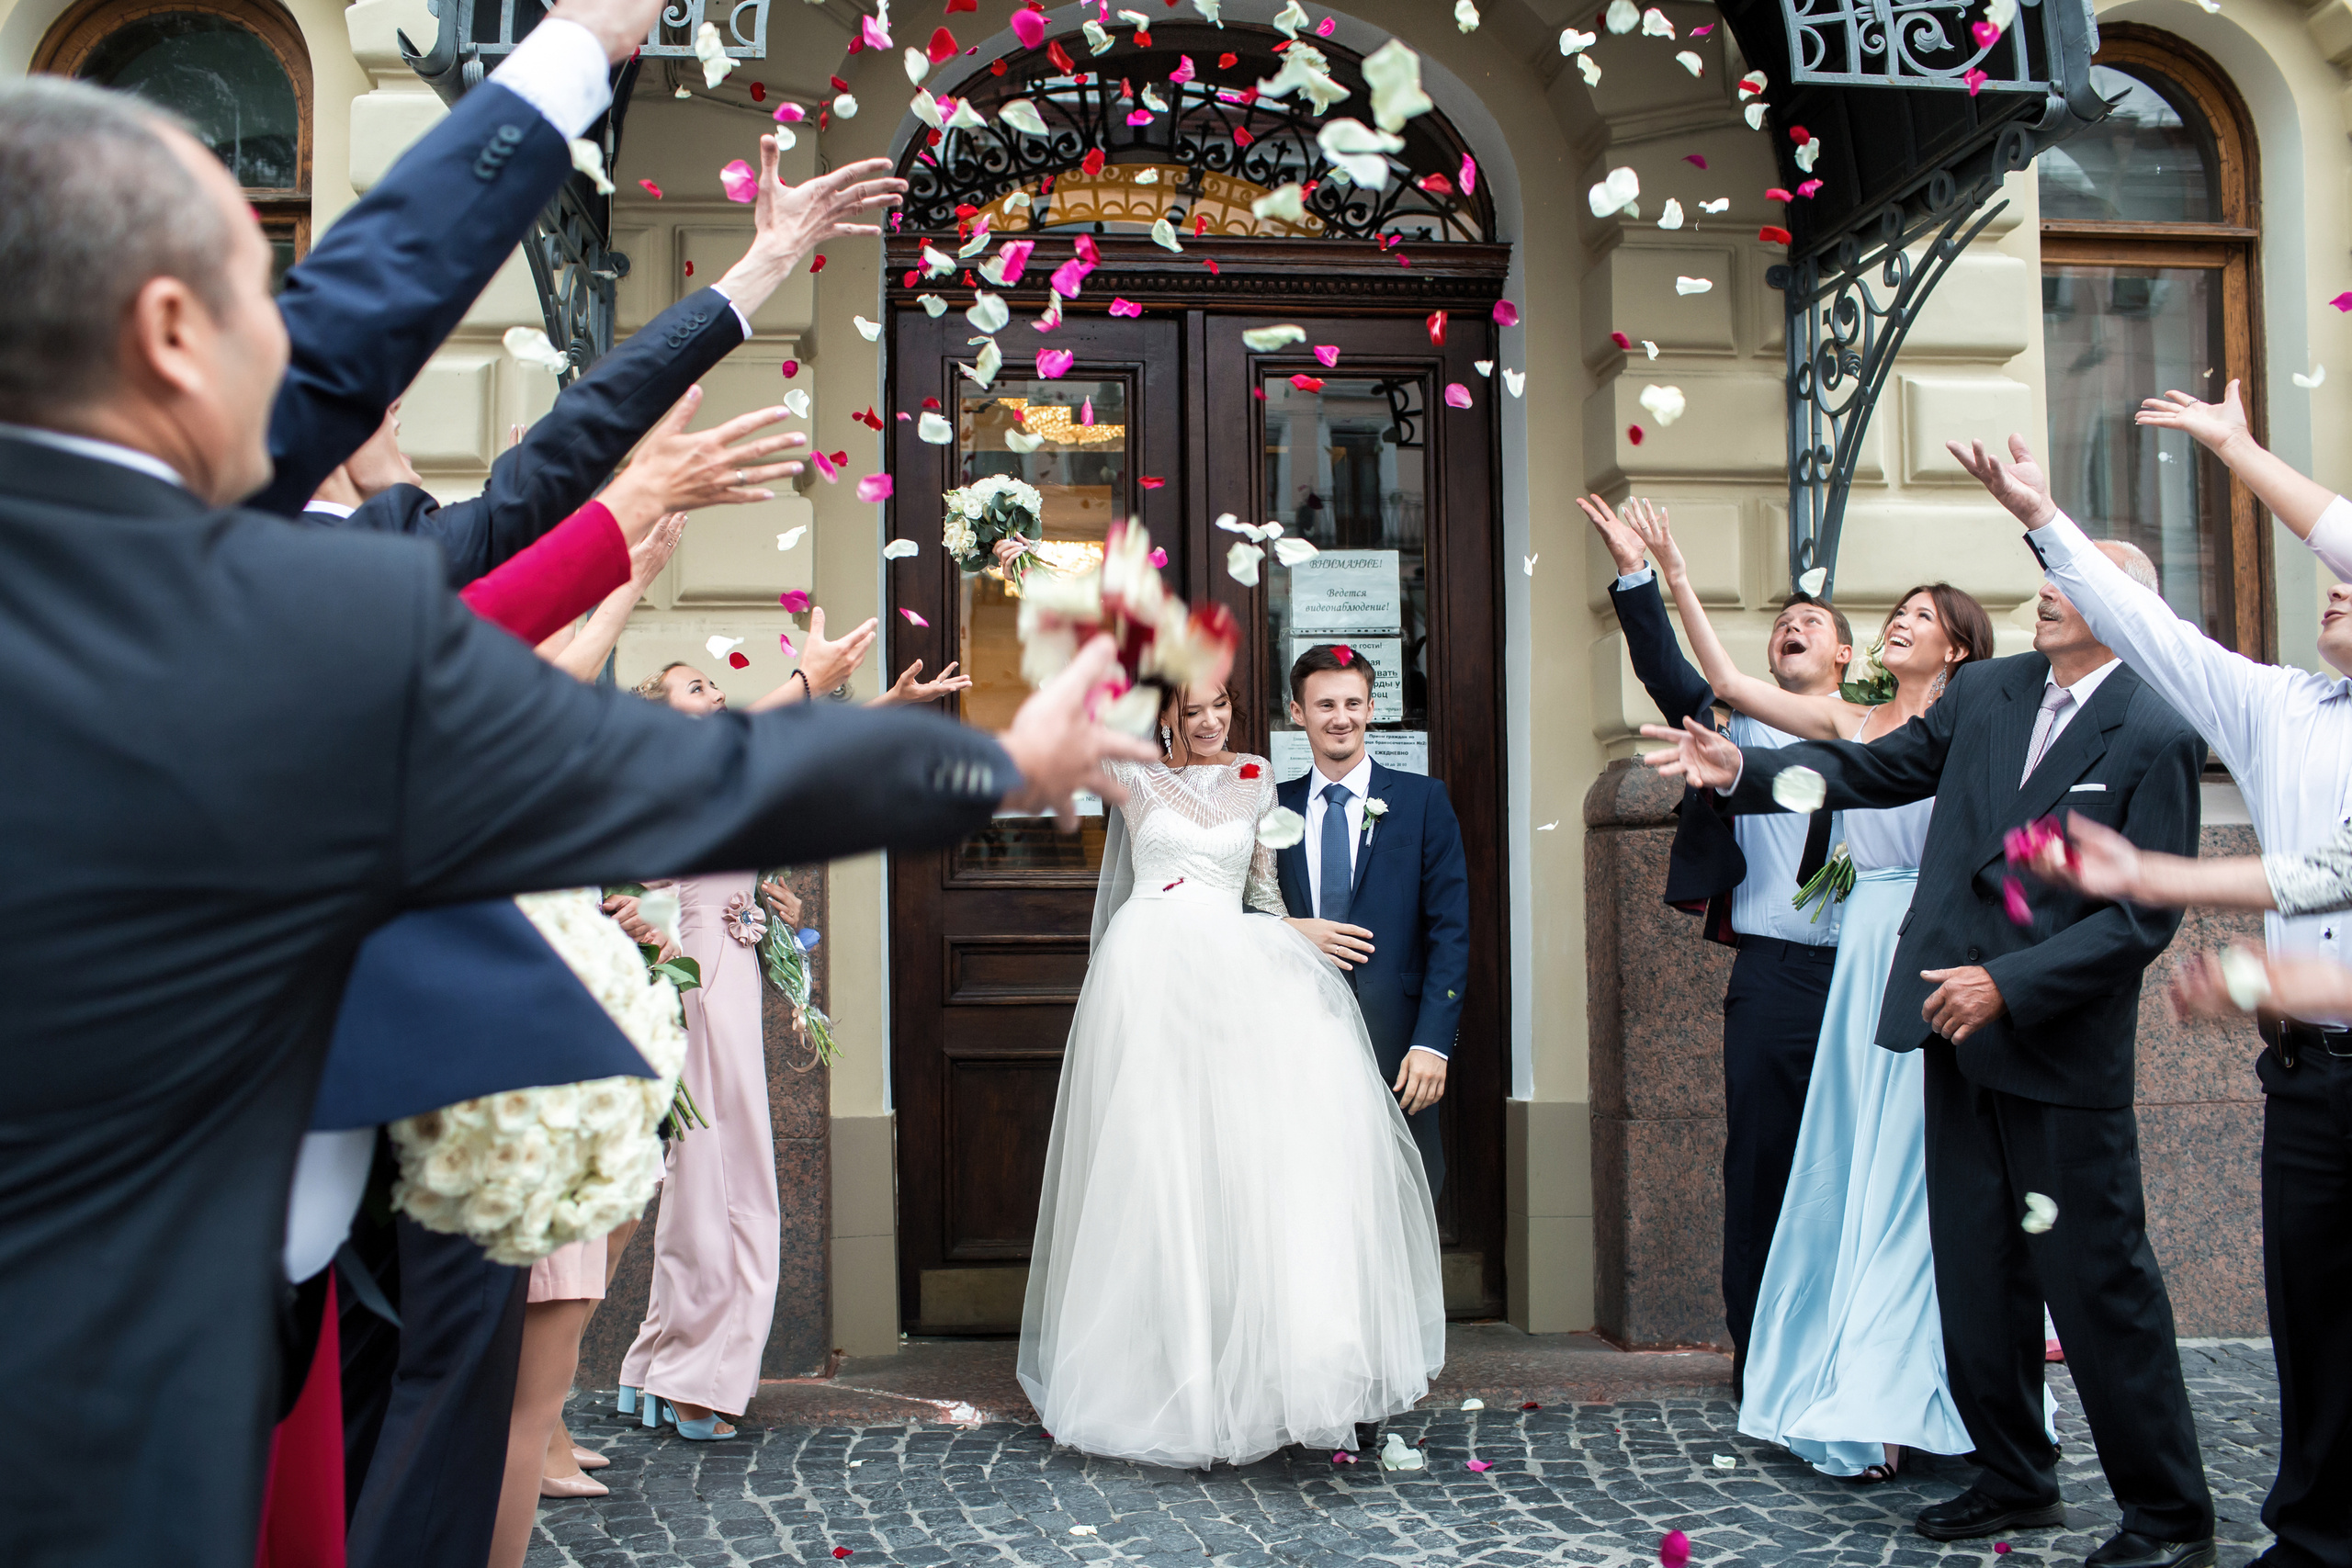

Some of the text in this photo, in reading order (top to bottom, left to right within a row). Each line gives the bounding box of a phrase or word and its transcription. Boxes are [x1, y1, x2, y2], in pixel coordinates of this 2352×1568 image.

[1309, 558, 1383, 570] ВНИМАНИЕ!
[1326, 588, 1367, 598] Ведется
[1305, 602, 1390, 612] видеонаблюдение!
